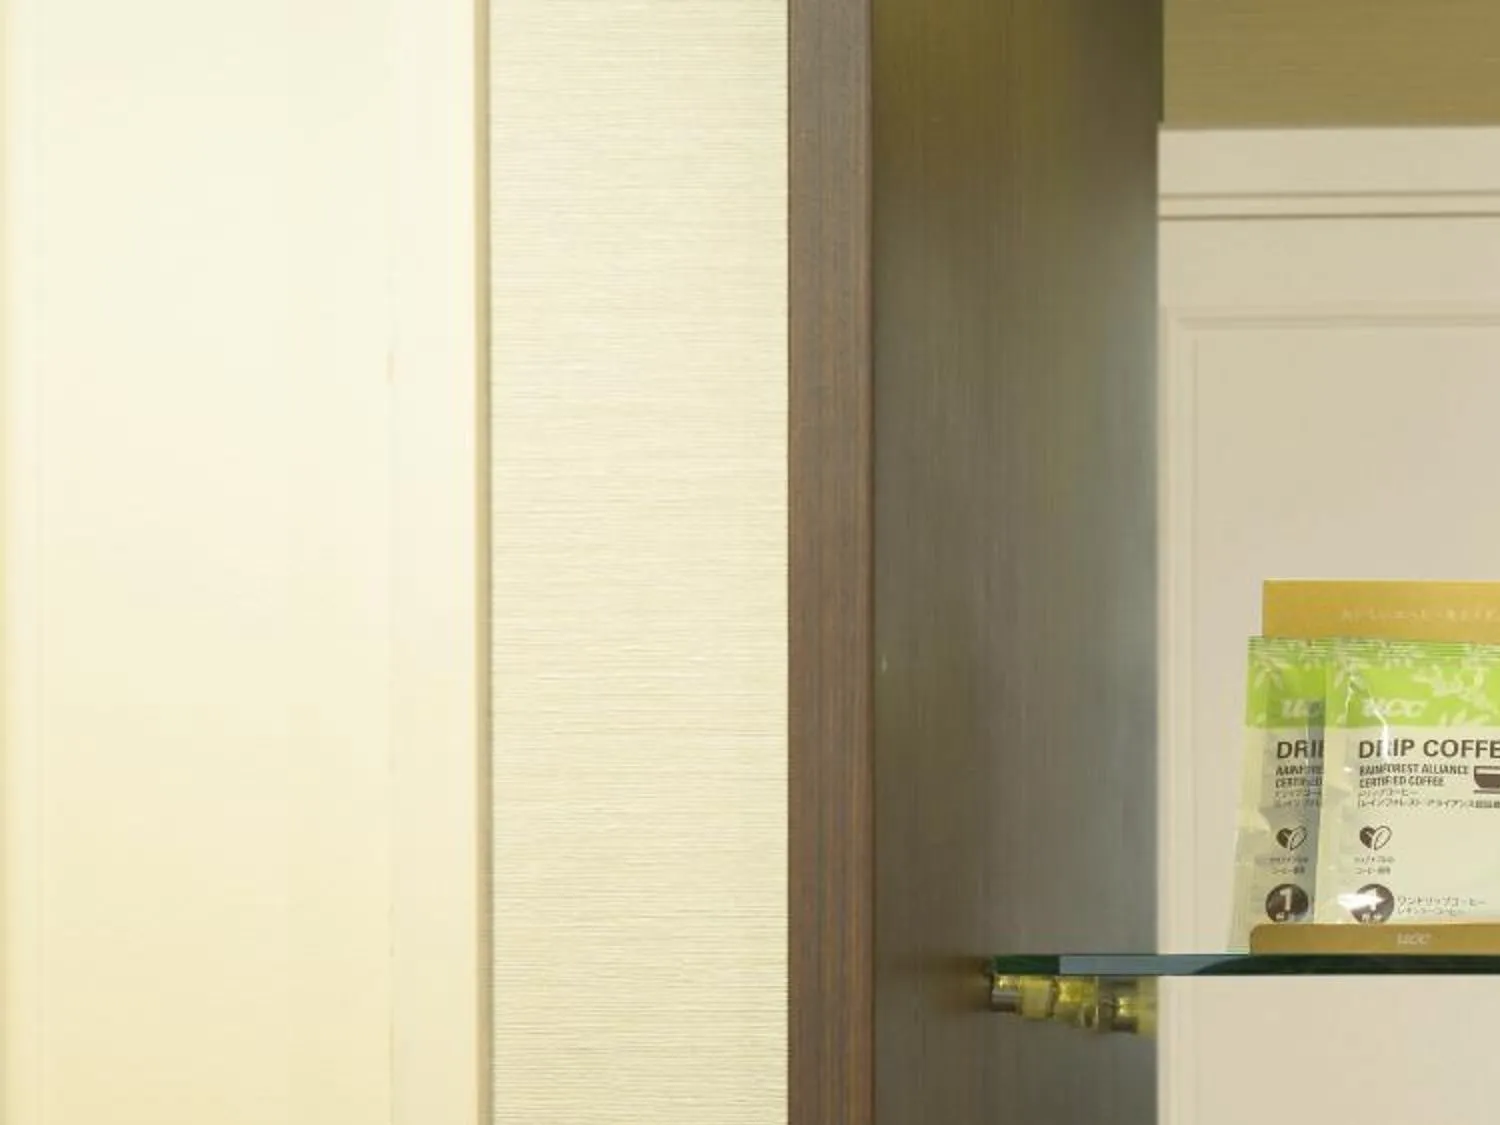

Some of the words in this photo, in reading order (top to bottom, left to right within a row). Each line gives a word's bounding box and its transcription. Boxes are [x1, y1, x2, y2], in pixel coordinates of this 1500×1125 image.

[1360, 764, 1420, 777] RAINFOREST
[1421, 764, 1469, 775] ALLIANCE
[1359, 776, 1406, 788] CERTIFIED
[1408, 776, 1444, 787] COFFEE
